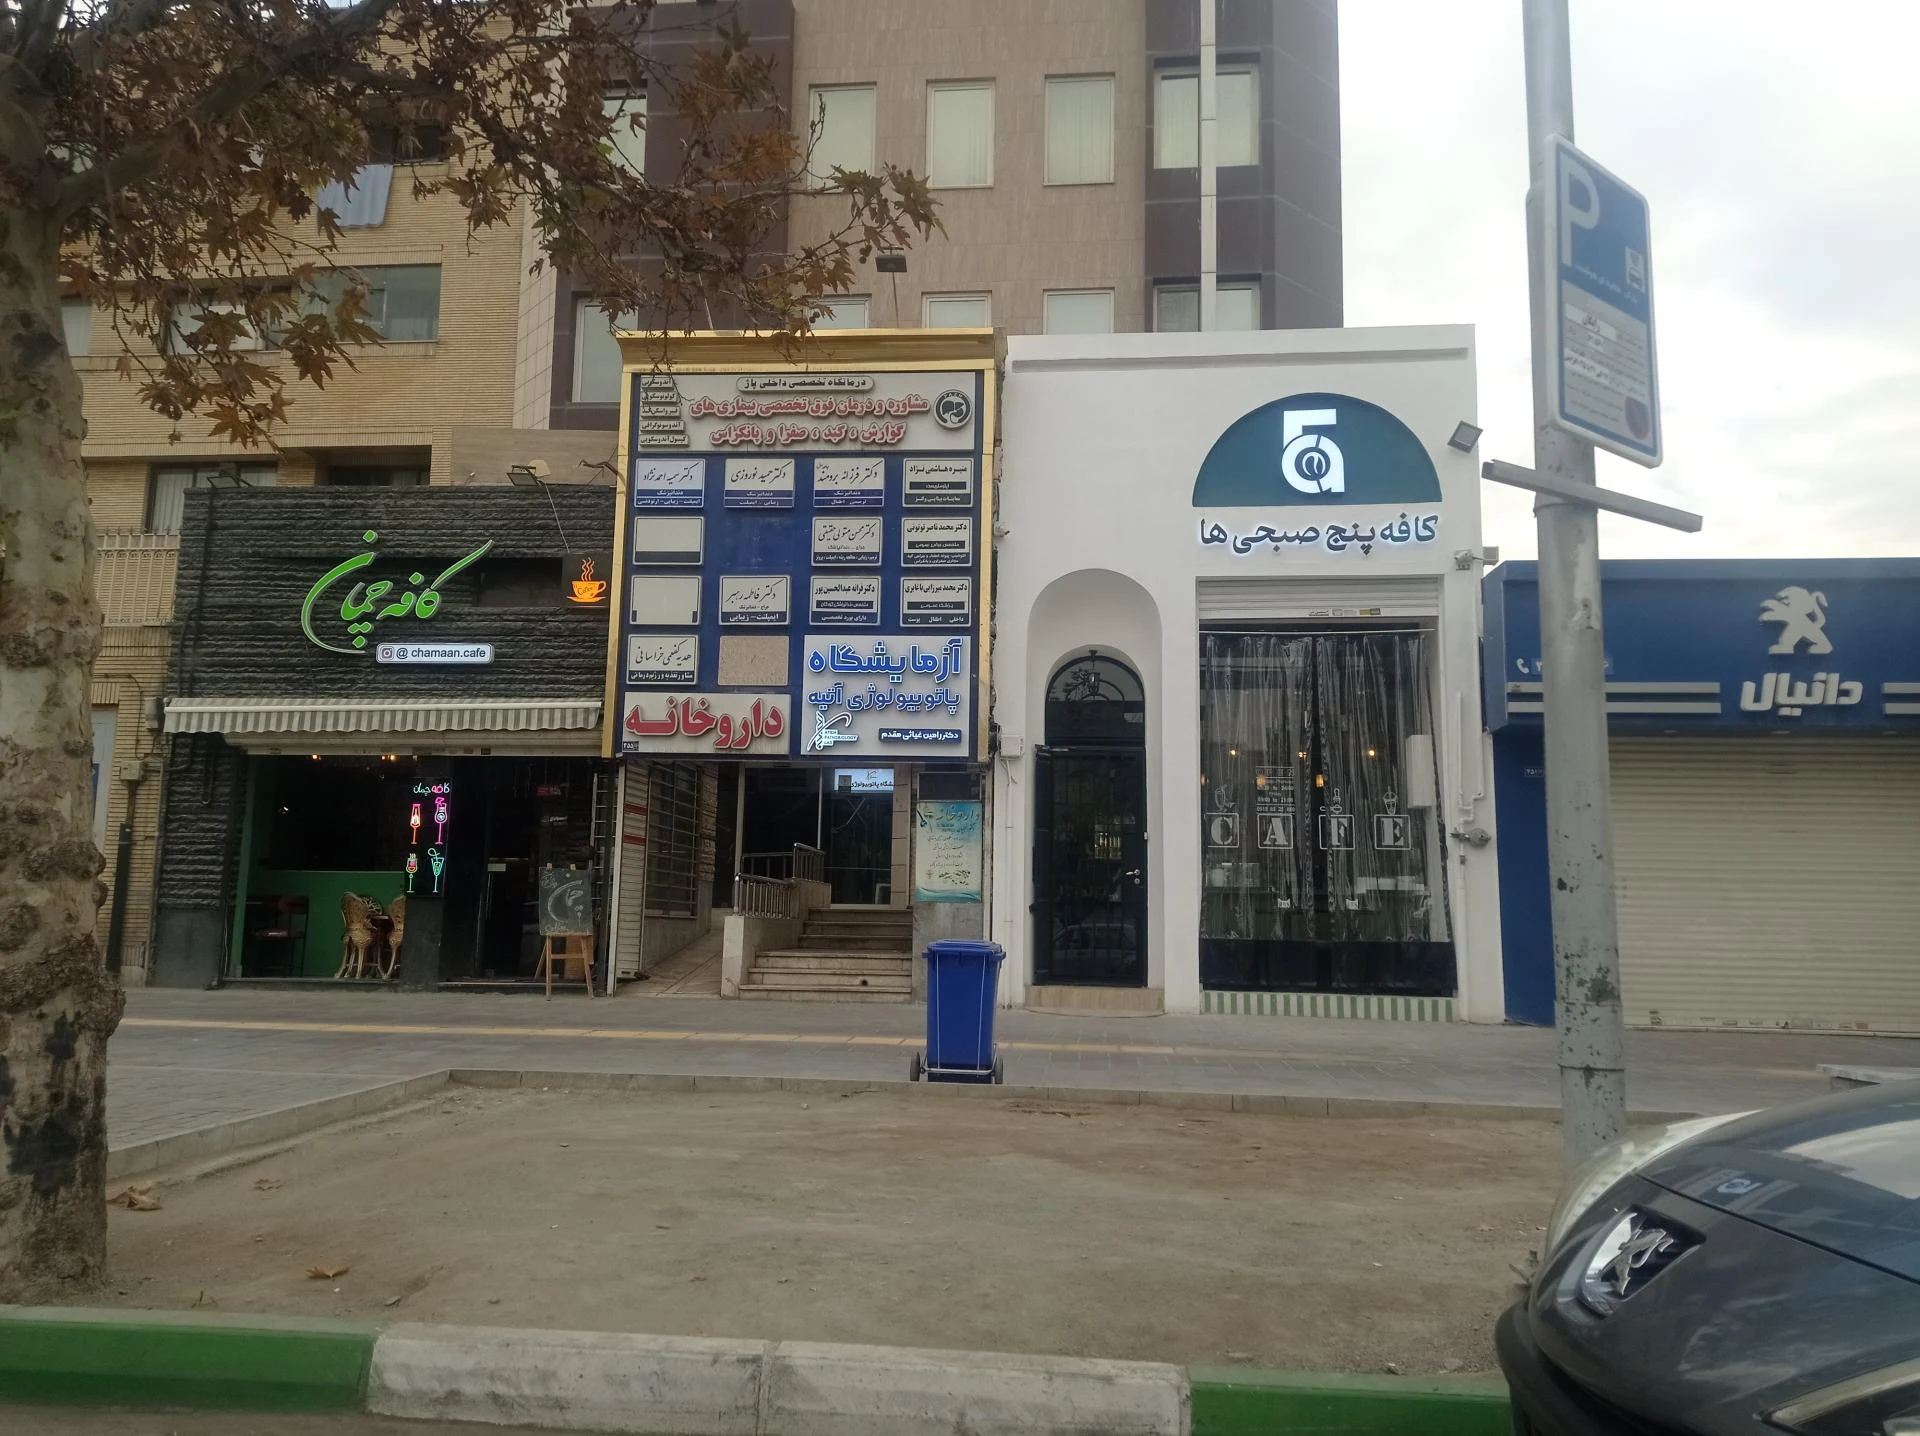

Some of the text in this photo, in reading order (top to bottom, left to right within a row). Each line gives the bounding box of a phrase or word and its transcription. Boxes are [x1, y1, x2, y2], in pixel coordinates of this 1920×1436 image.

[1559, 151, 1599, 266] P
[760, 378, 787, 388] داخلی
[789, 377, 825, 389] تخصصی
[758, 397, 809, 416] تخصصی
[810, 399, 836, 415] فوق
[837, 397, 874, 415] درمان
[874, 400, 887, 414] و
[886, 394, 930, 413] مشاوره
[710, 424, 763, 446] پانکراس
[778, 422, 808, 443] صفرا
[822, 421, 848, 444] کبد
[860, 422, 906, 444] گوارش
[679, 462, 700, 483] دکتر
[731, 466, 758, 483] نوروزی
[769, 460, 793, 484] دکتر
[816, 460, 884, 485] دکتر فرزانه برومند
[858, 521, 878, 541] دکتر
[938, 523, 954, 532] محمد
[953, 522, 968, 533] دکتر
[1200, 511, 1440, 556] کافه پنج صبحی ها
[759, 578, 785, 603] دکتر
[863, 583, 876, 595] دکتر
[942, 584, 956, 592] محمد
[955, 583, 968, 593] دکتر
[756, 612, 779, 622] ایمپلنت
[395, 647, 486, 660] @ chamaan.cafe
[635, 645, 664, 664] خراسانی
[808, 637, 963, 683] آزمایشگاه
[807, 681, 961, 715] پاتوبیولوژی آتیه
[1739, 671, 1863, 717] دانیال
[624, 695, 784, 750] داروخانه
[881, 730, 902, 741] مقدم
[942, 730, 959, 741] دکتر
[431, 782, 450, 794] کافه
